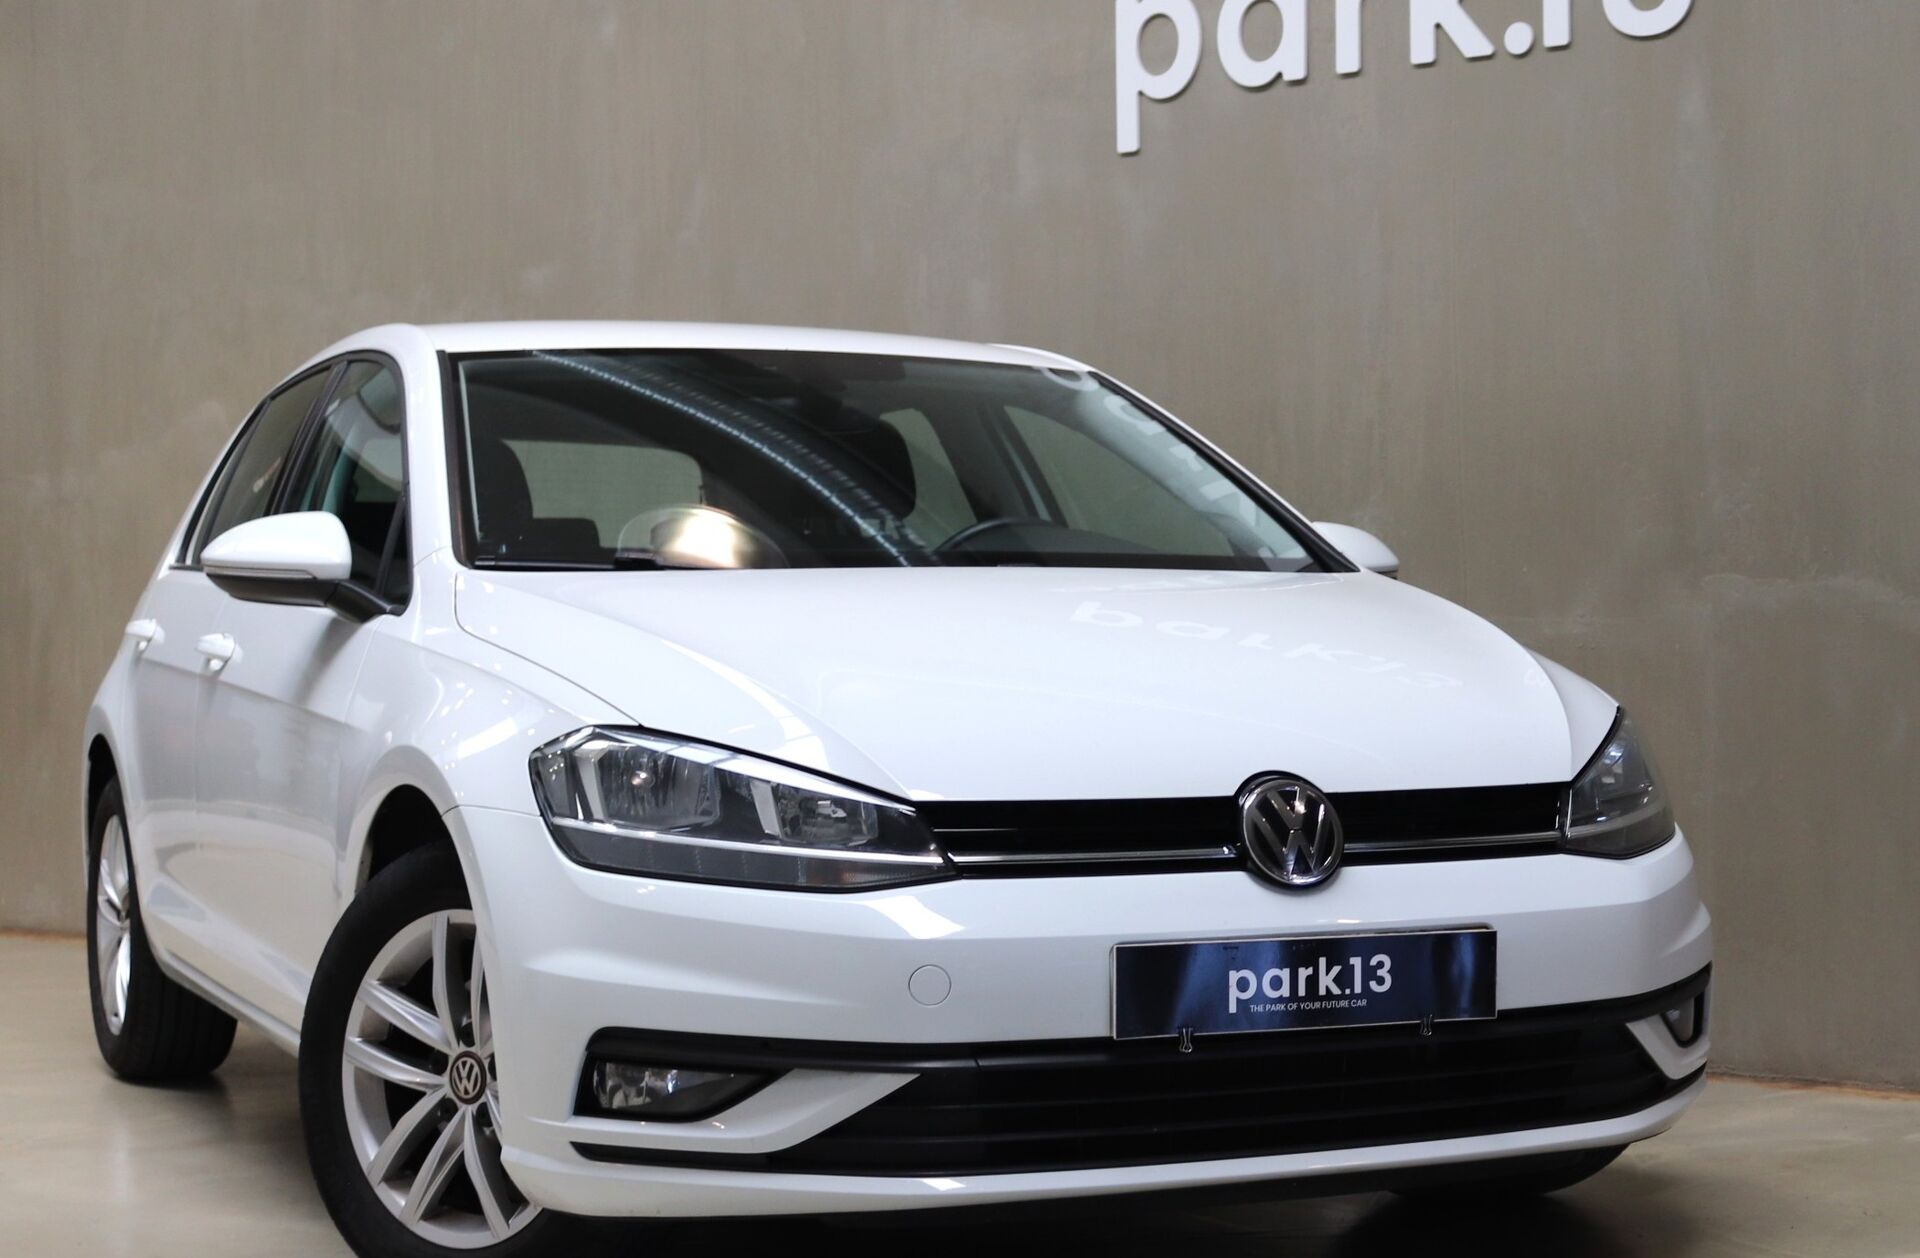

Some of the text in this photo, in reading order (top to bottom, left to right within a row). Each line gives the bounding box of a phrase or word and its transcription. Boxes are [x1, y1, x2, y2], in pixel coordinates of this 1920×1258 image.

[1243, 778, 1343, 884] VW
[1228, 953, 1392, 1014] park.13
[1250, 998, 1367, 1013] THE PARK OF YOUR FUTURE CAR
[451, 1056, 482, 1099] VW
